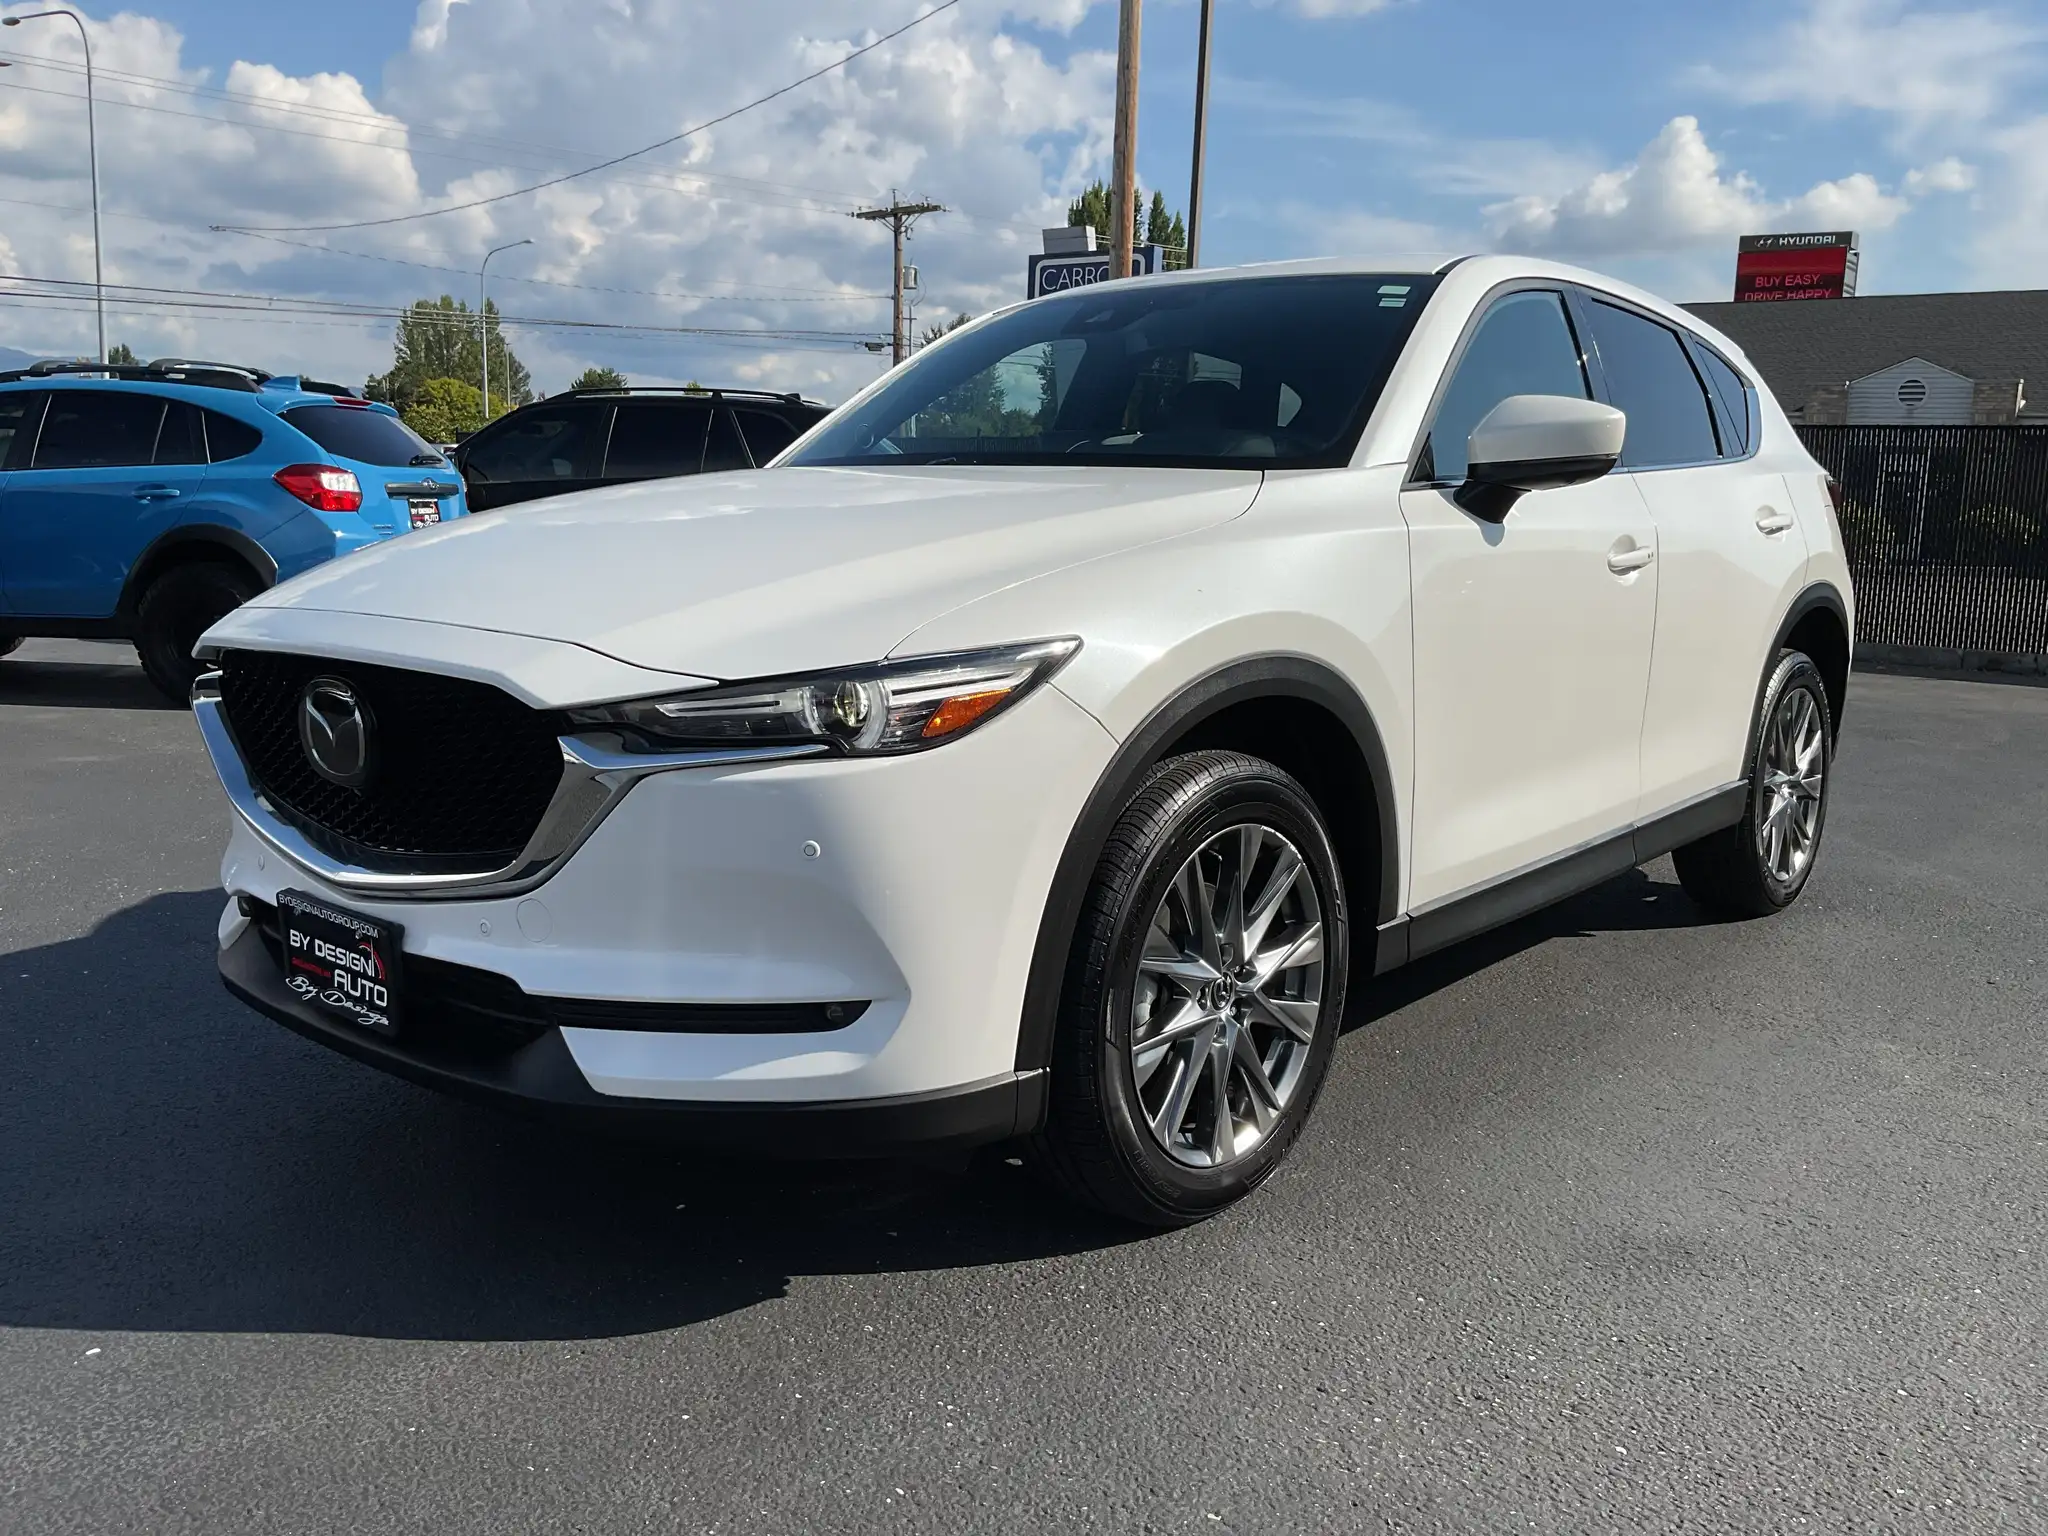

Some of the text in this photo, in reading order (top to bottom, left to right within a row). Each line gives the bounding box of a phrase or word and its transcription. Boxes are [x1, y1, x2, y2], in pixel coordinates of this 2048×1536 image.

[1779, 235, 1836, 246] HYUNDAI
[1755, 276, 1782, 288] BUY
[278, 893, 379, 939] BYDESIGNAUTOGROUP.COM
[289, 928, 311, 951] BY
[314, 938, 375, 978] DESIGN
[285, 975, 319, 1000] By
[334, 968, 388, 1007] AUTO
